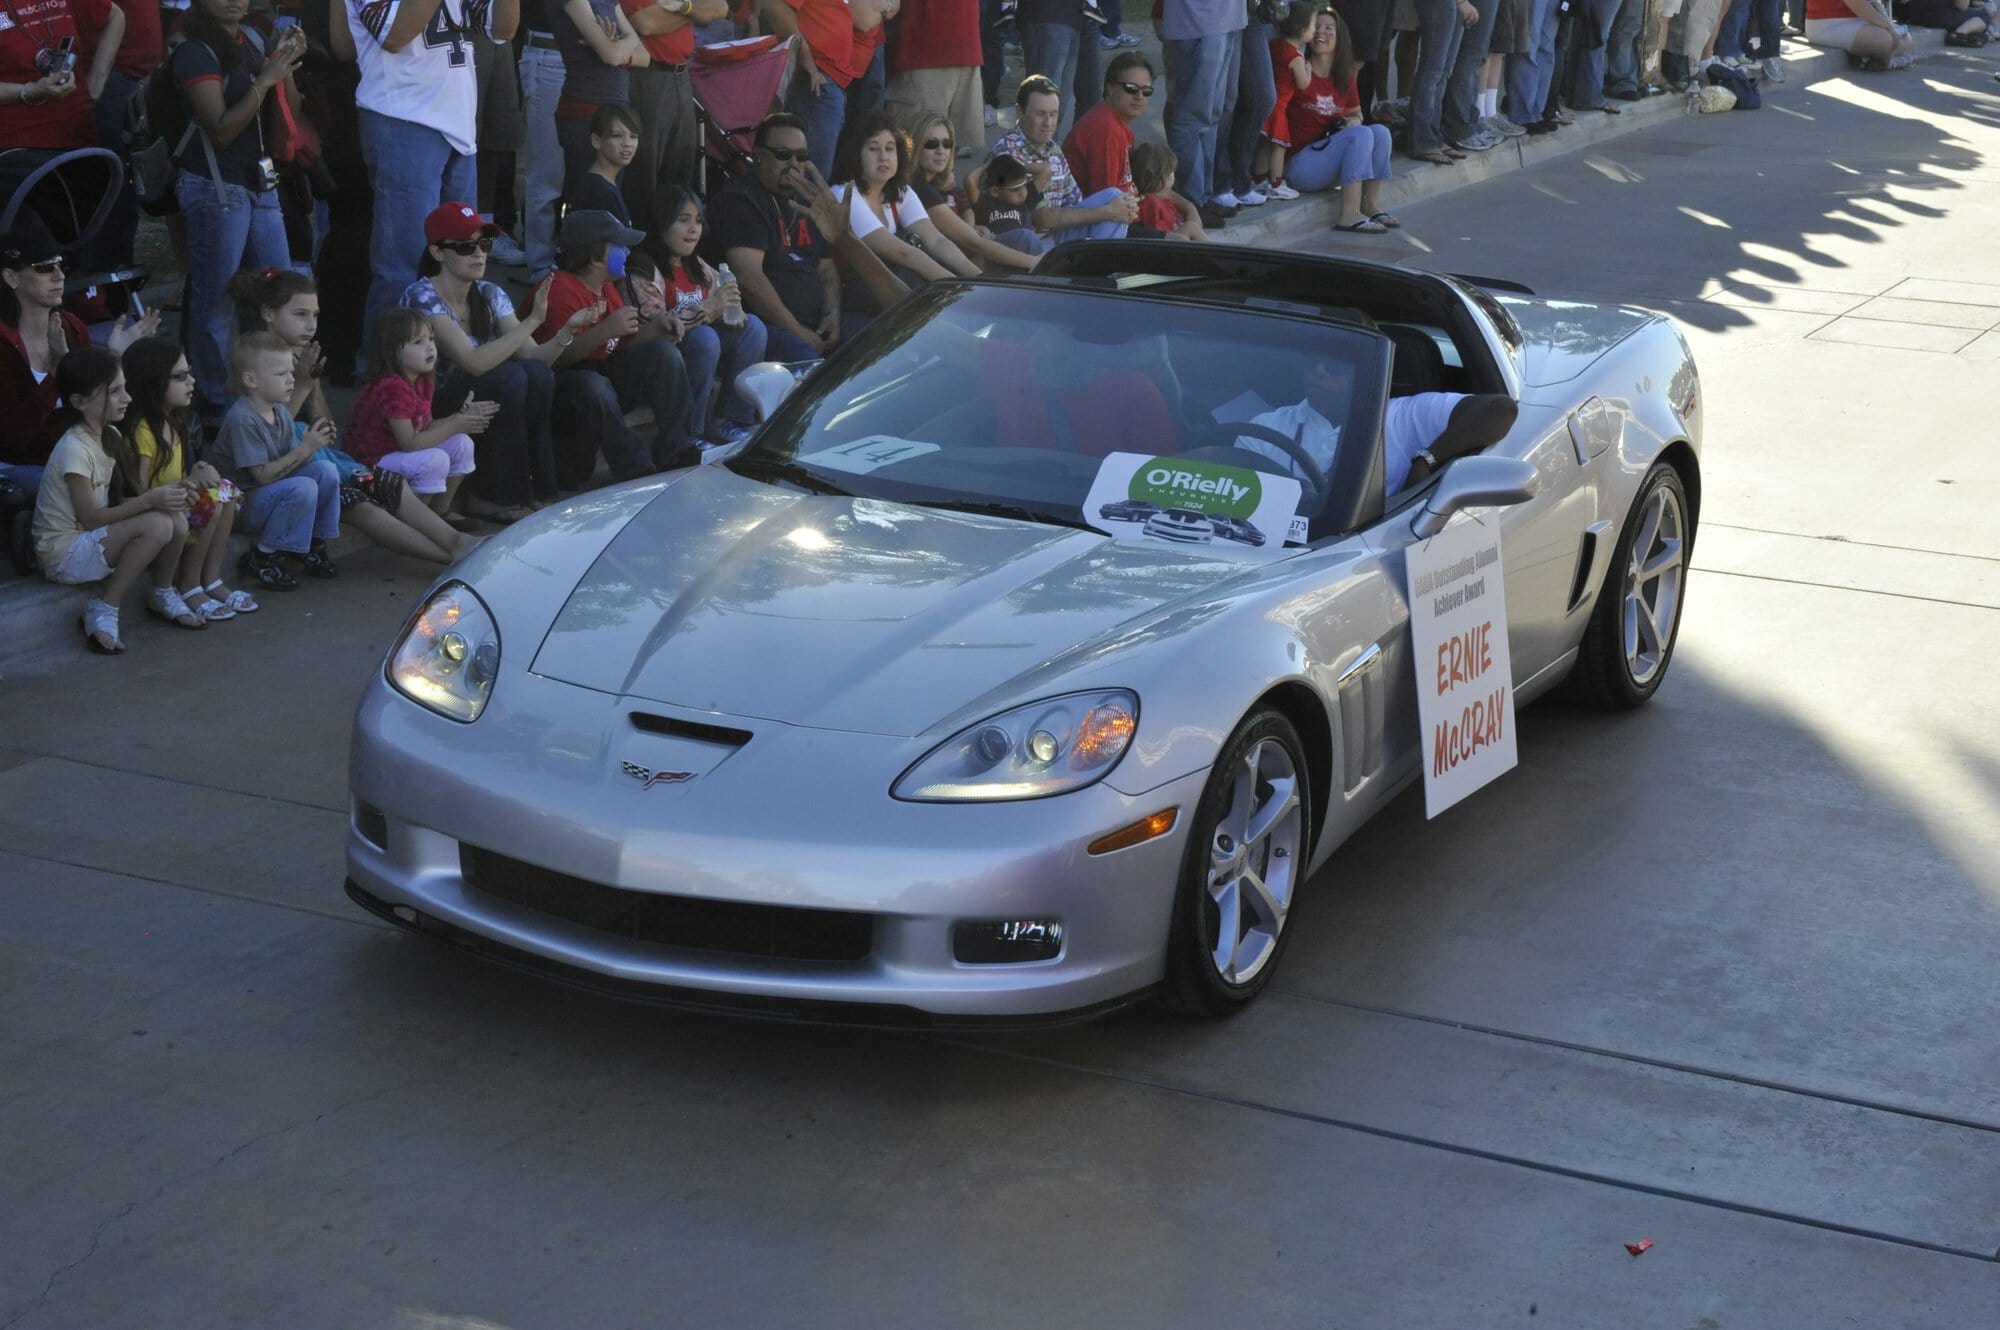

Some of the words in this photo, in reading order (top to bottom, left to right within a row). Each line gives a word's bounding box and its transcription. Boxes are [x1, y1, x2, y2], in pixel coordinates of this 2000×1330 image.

[1146, 468, 1250, 501] O'Rielly
[1149, 487, 1236, 506] CHEVROLET
[1433, 589, 1464, 618] Achiever
[1464, 575, 1485, 603] Award
[1437, 620, 1493, 697] ERNIE
[1433, 686, 1505, 778] McCRAY
